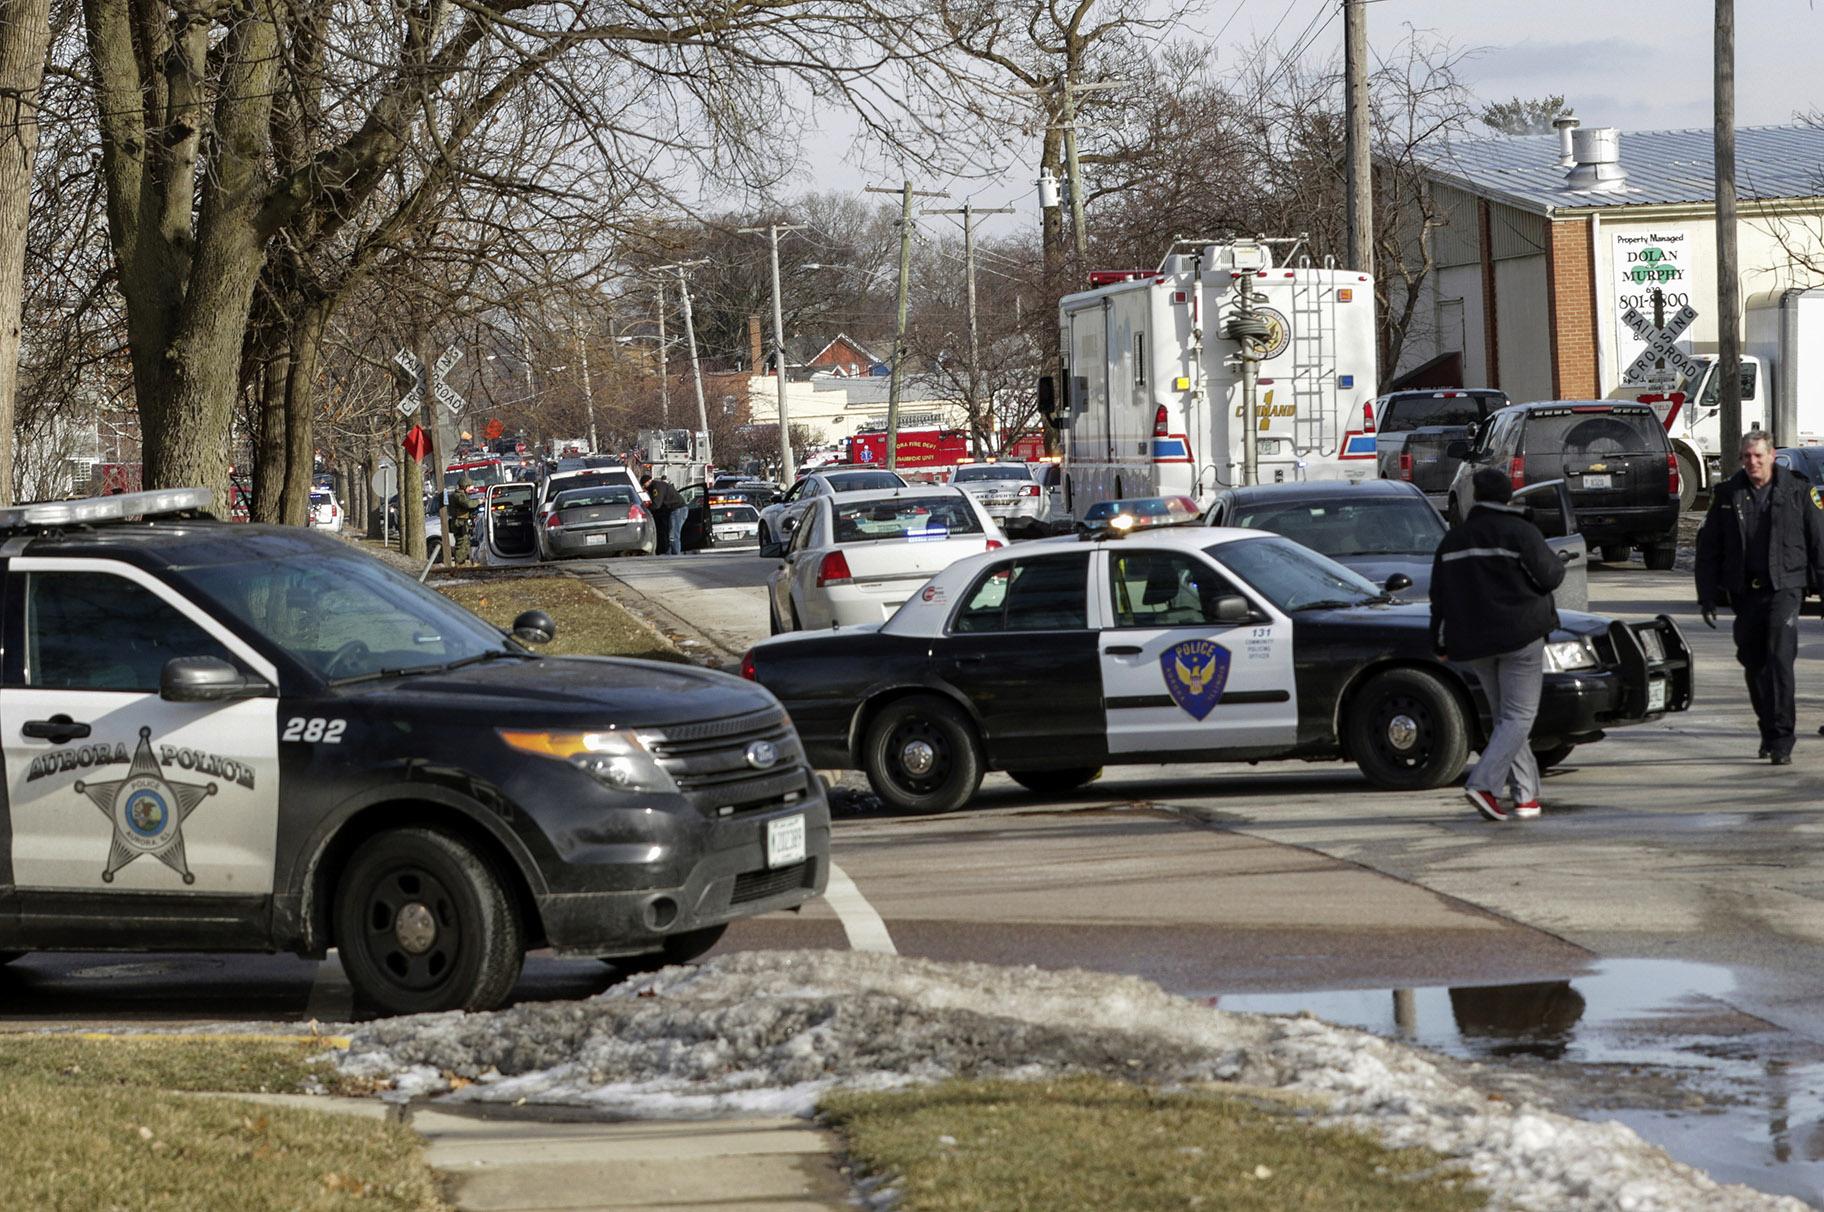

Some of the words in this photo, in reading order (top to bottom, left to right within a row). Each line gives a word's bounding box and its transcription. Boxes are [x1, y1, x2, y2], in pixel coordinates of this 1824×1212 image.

[1617, 235, 1648, 245] Property
[1649, 233, 1684, 243] Managed
[1626, 250, 1678, 263] DOLAN
[1621, 268, 1685, 282] MURPHY
[1624, 310, 1655, 343] RAIL
[1663, 346, 1696, 377] ROAD
[1628, 307, 1694, 380] CROSSING
[434, 382, 462, 409] ROAD
[1252, 627, 1271, 638] 131
[1175, 641, 1217, 658] POLICE
[281, 716, 348, 744] 282
[26, 741, 131, 783] AURORA
[159, 743, 257, 790] POLICE
[130, 778, 161, 791] POLICE
